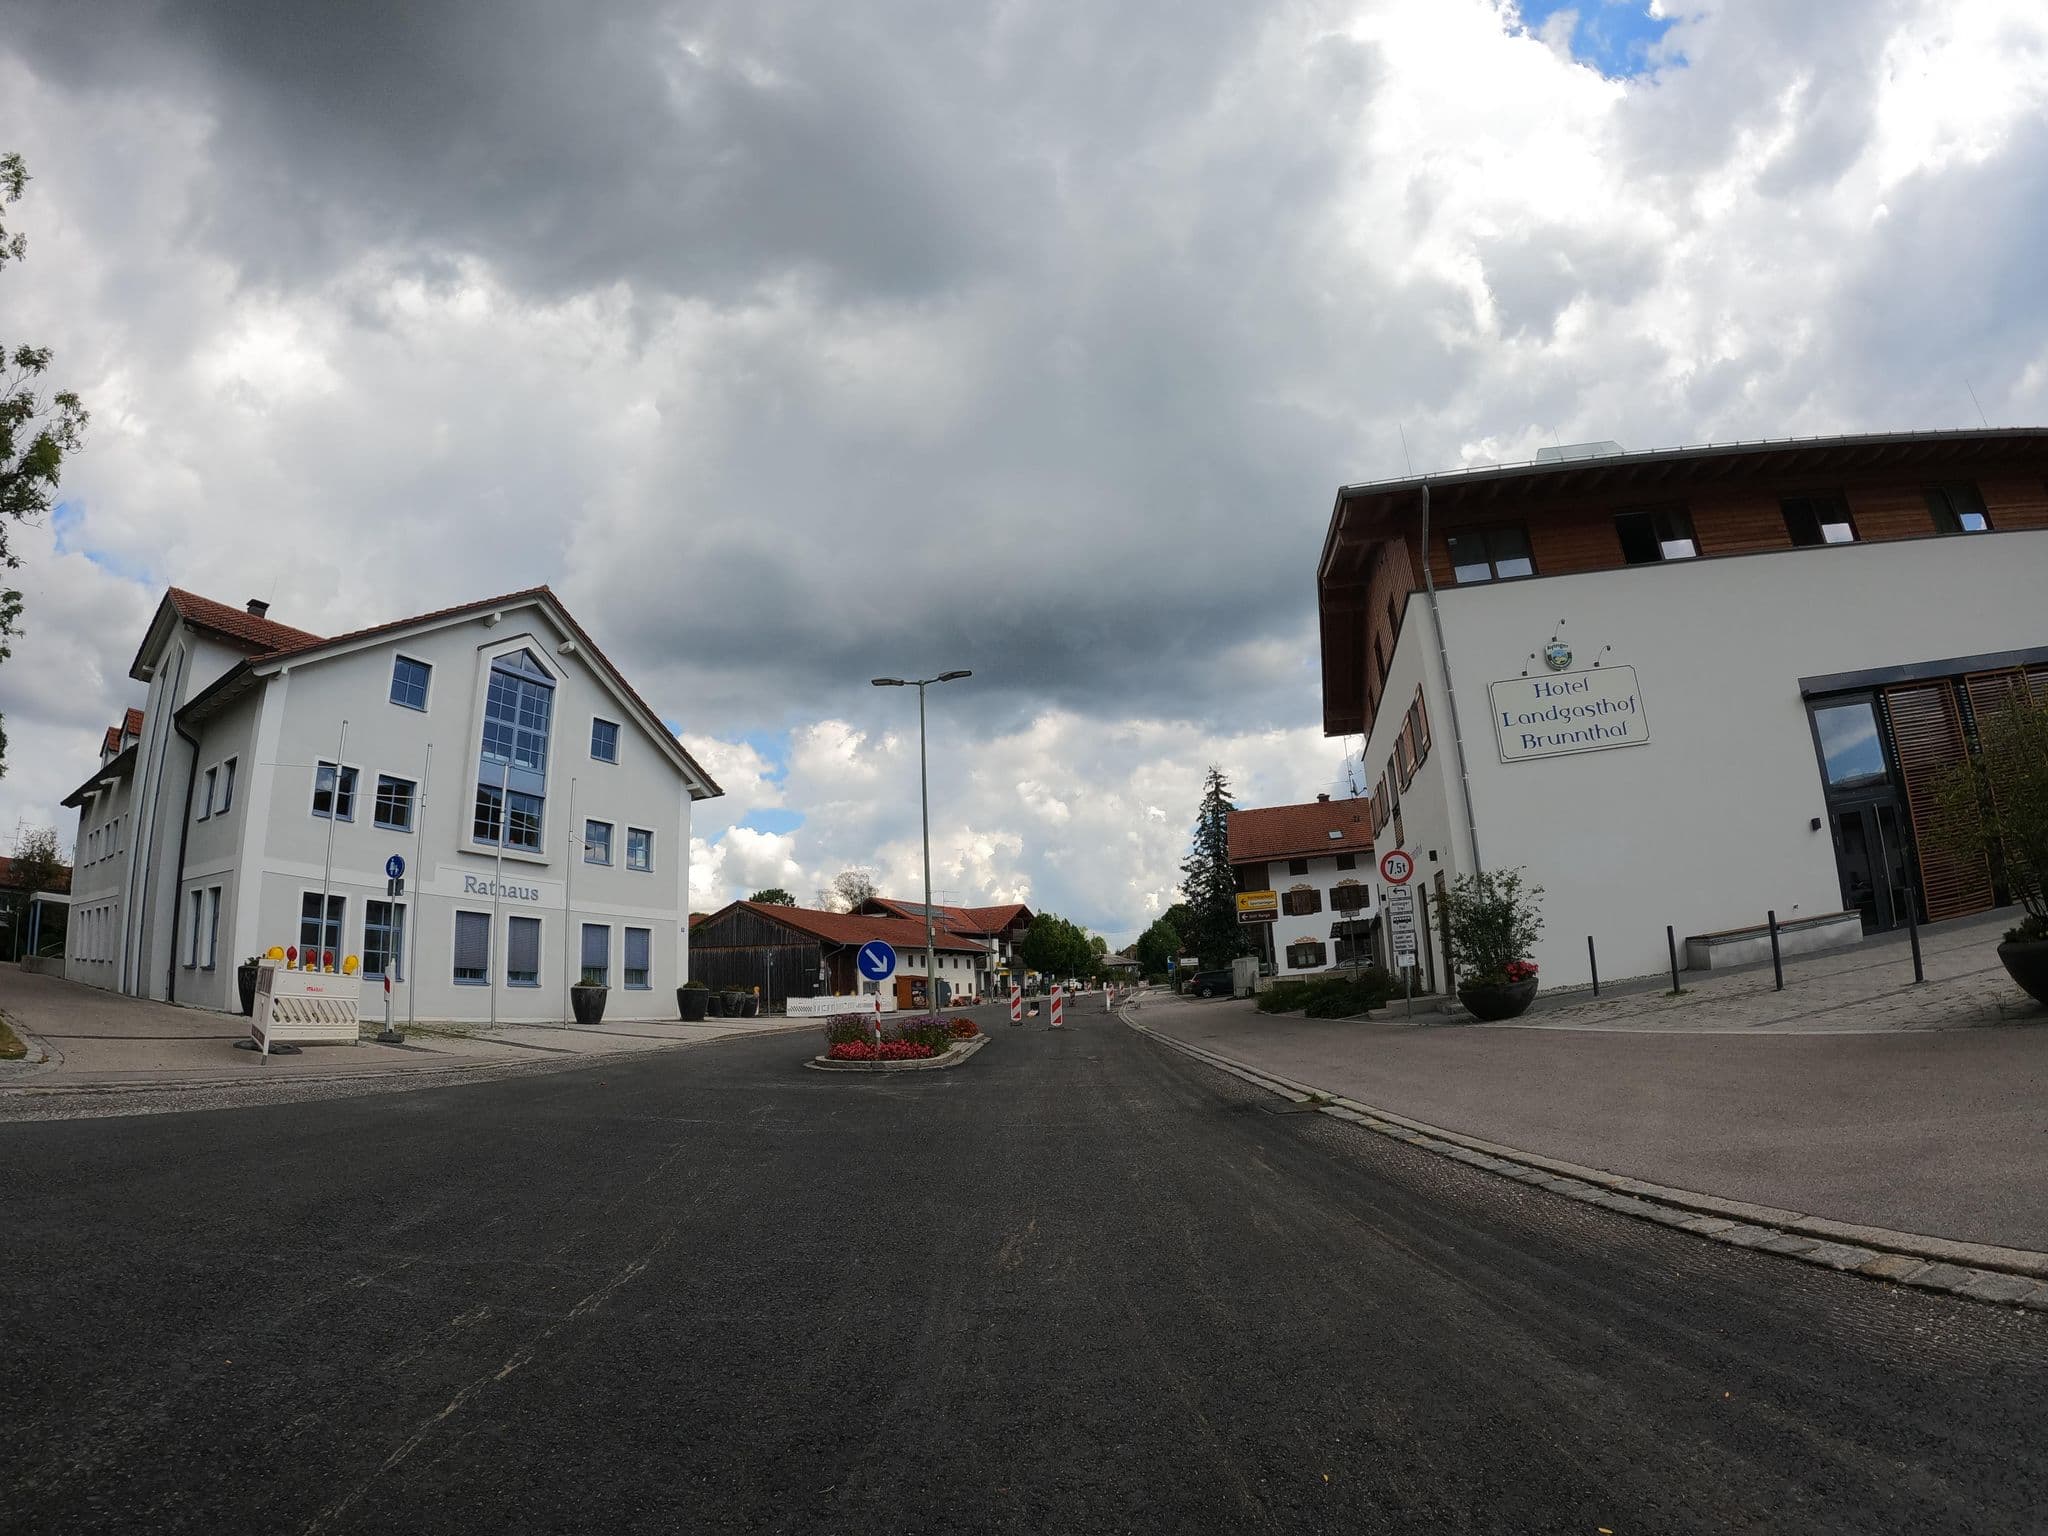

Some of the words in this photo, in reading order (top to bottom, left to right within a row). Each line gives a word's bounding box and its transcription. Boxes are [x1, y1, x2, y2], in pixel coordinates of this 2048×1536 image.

[1533, 677, 1589, 698] Hotel
[1501, 695, 1635, 727] Landgasthof
[1520, 721, 1627, 749] Brunnthal
